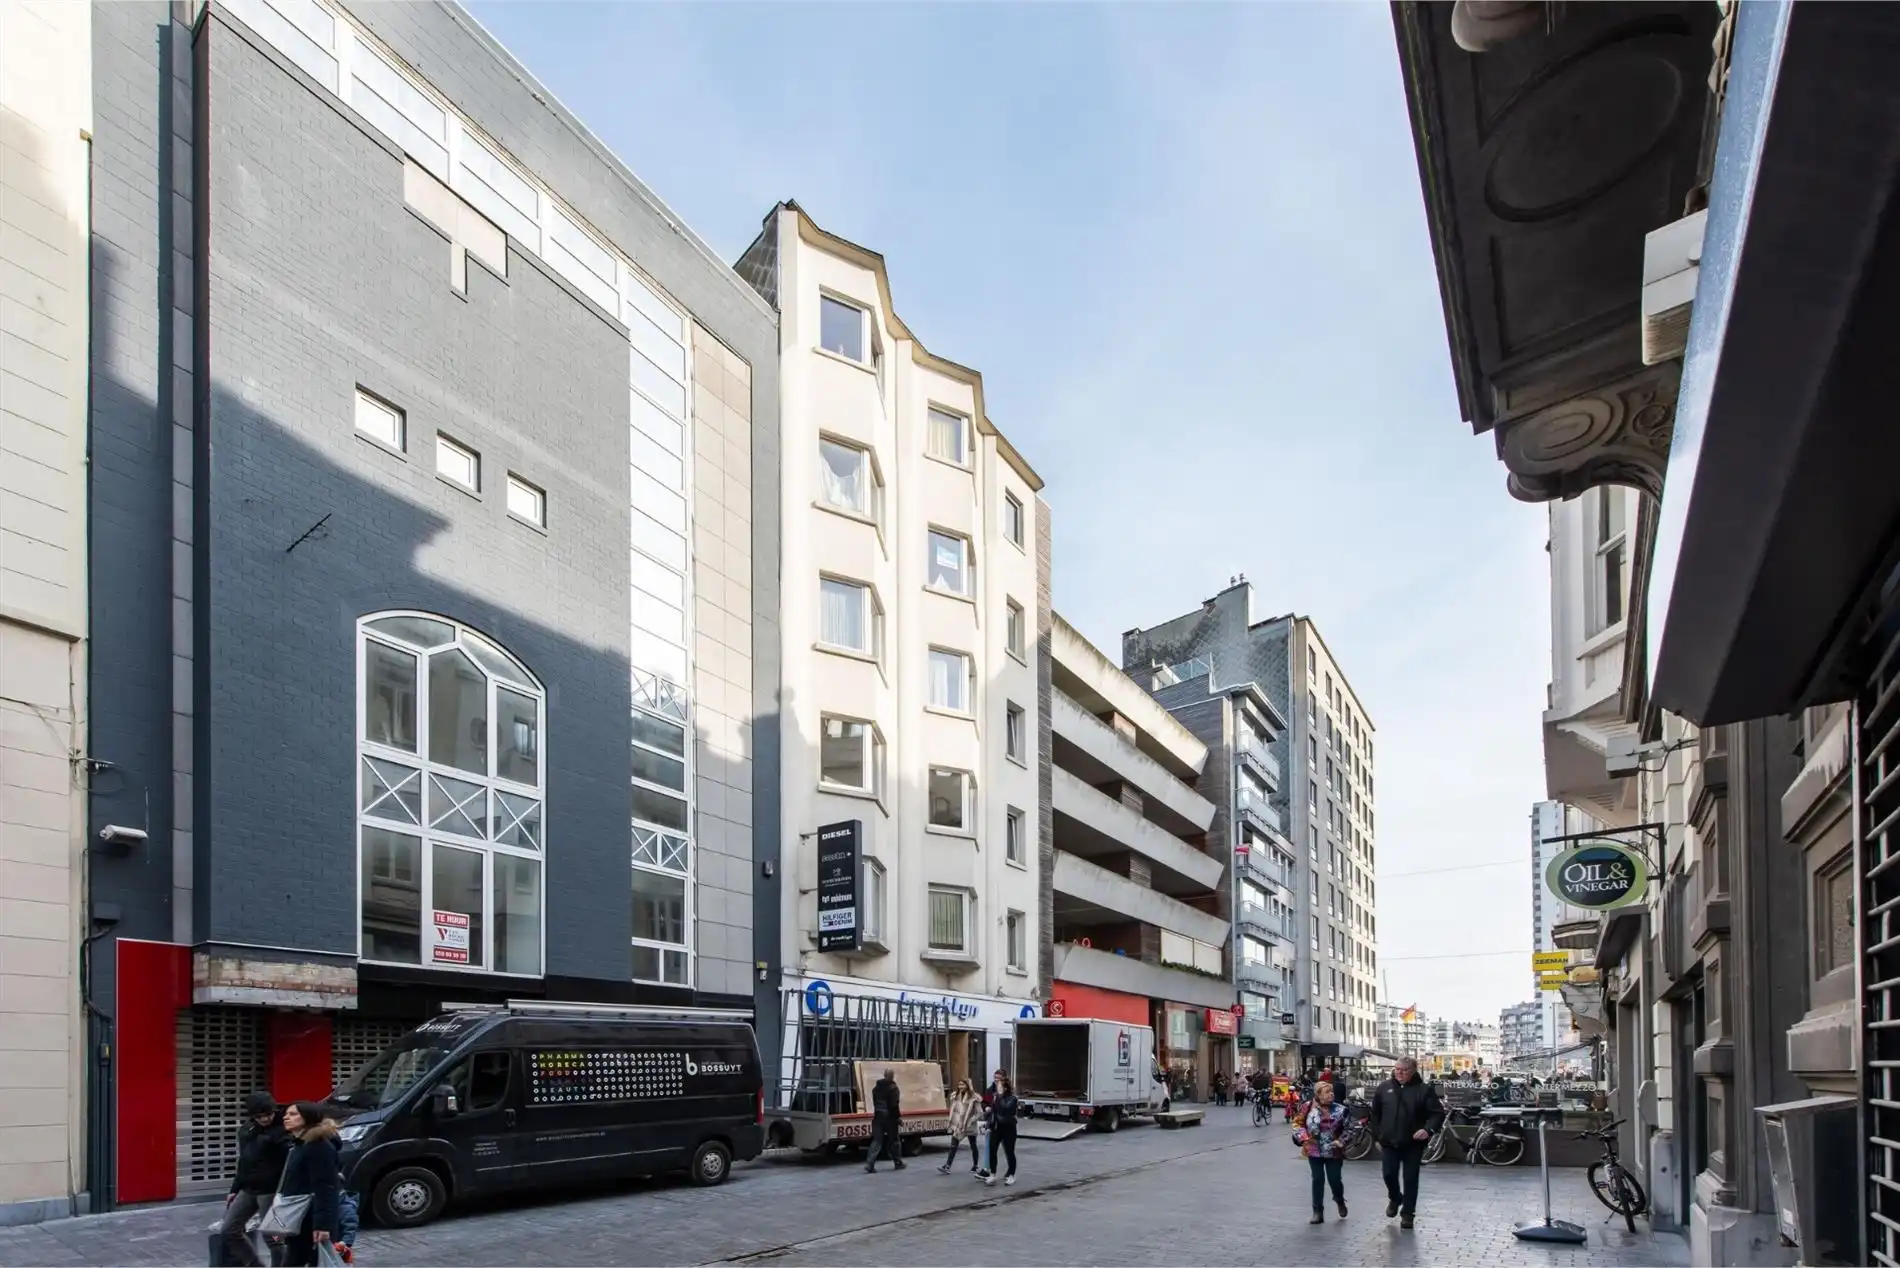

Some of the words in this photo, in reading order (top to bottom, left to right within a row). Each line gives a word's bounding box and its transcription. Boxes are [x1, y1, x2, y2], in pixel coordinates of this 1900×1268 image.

[821, 829, 851, 840] DIESEL
[1565, 880, 1629, 893] VINEGAR
[436, 914, 446, 922] TE
[822, 912, 852, 921] HILFIGER
[834, 918, 853, 926] DENIM
[701, 1064, 742, 1072] BOSSUYT
[541, 1086, 587, 1094] BEAUTY
